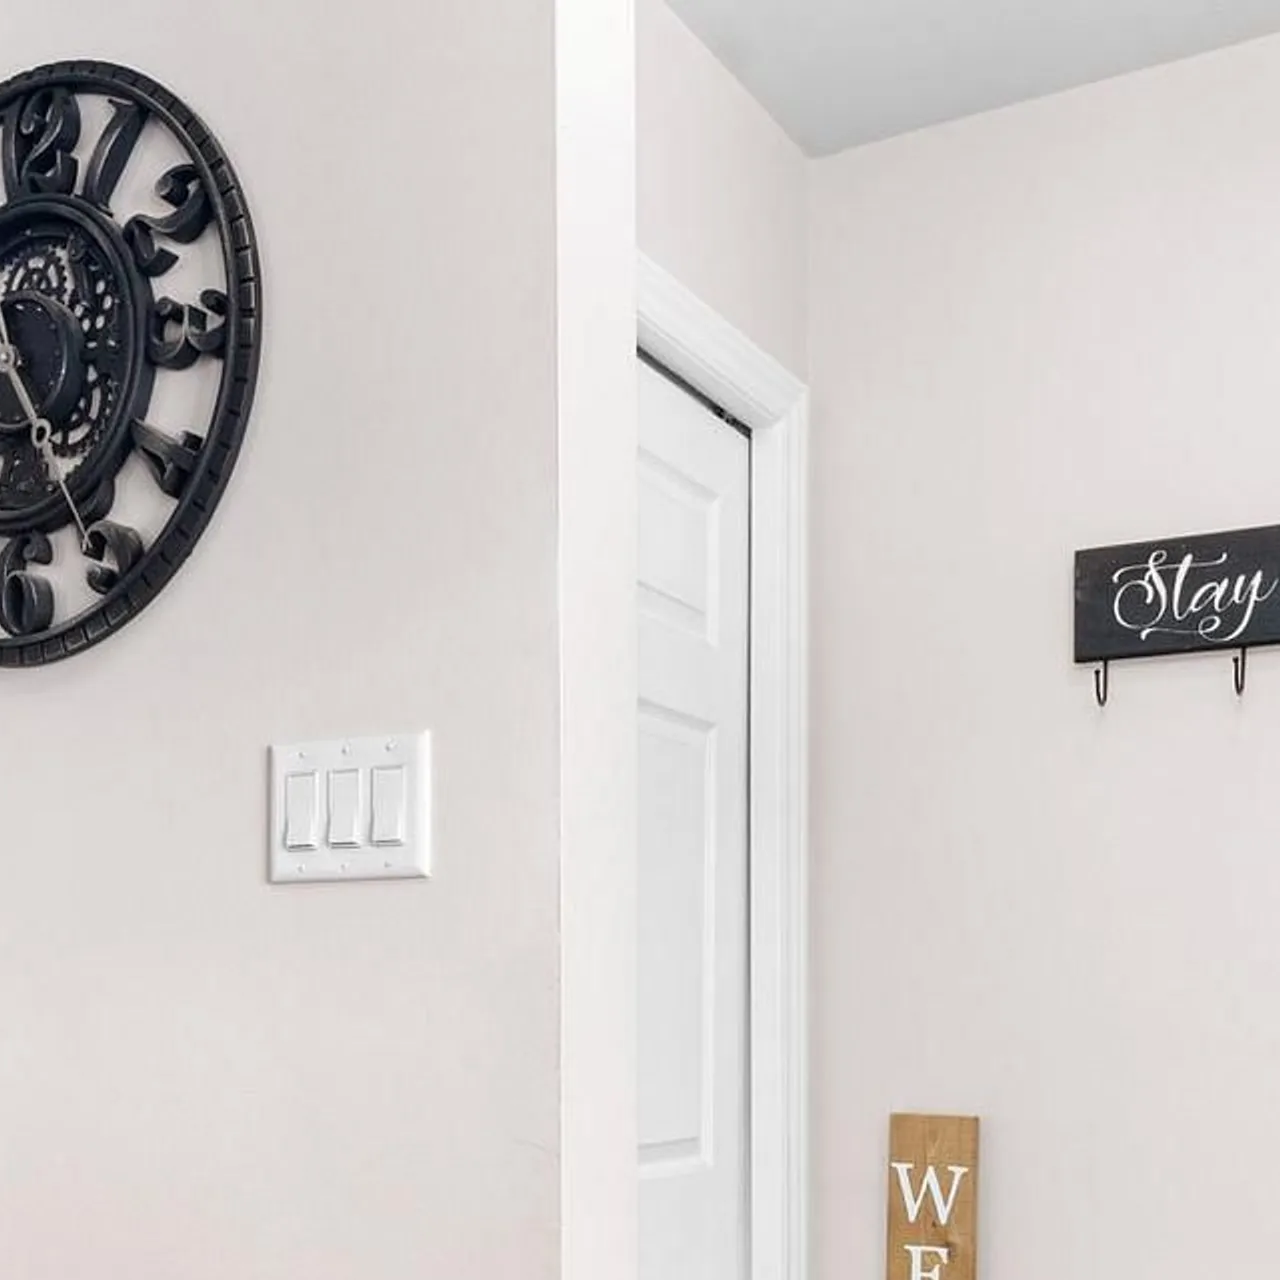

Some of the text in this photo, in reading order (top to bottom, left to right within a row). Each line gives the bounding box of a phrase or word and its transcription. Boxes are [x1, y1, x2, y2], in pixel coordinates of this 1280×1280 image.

[82, 97, 150, 217] 1
[122, 163, 216, 278] 2
[146, 289, 228, 372] 3
[132, 417, 205, 500] 4
[76, 474, 145, 596] 5
[1113, 549, 1278, 641] Stay
